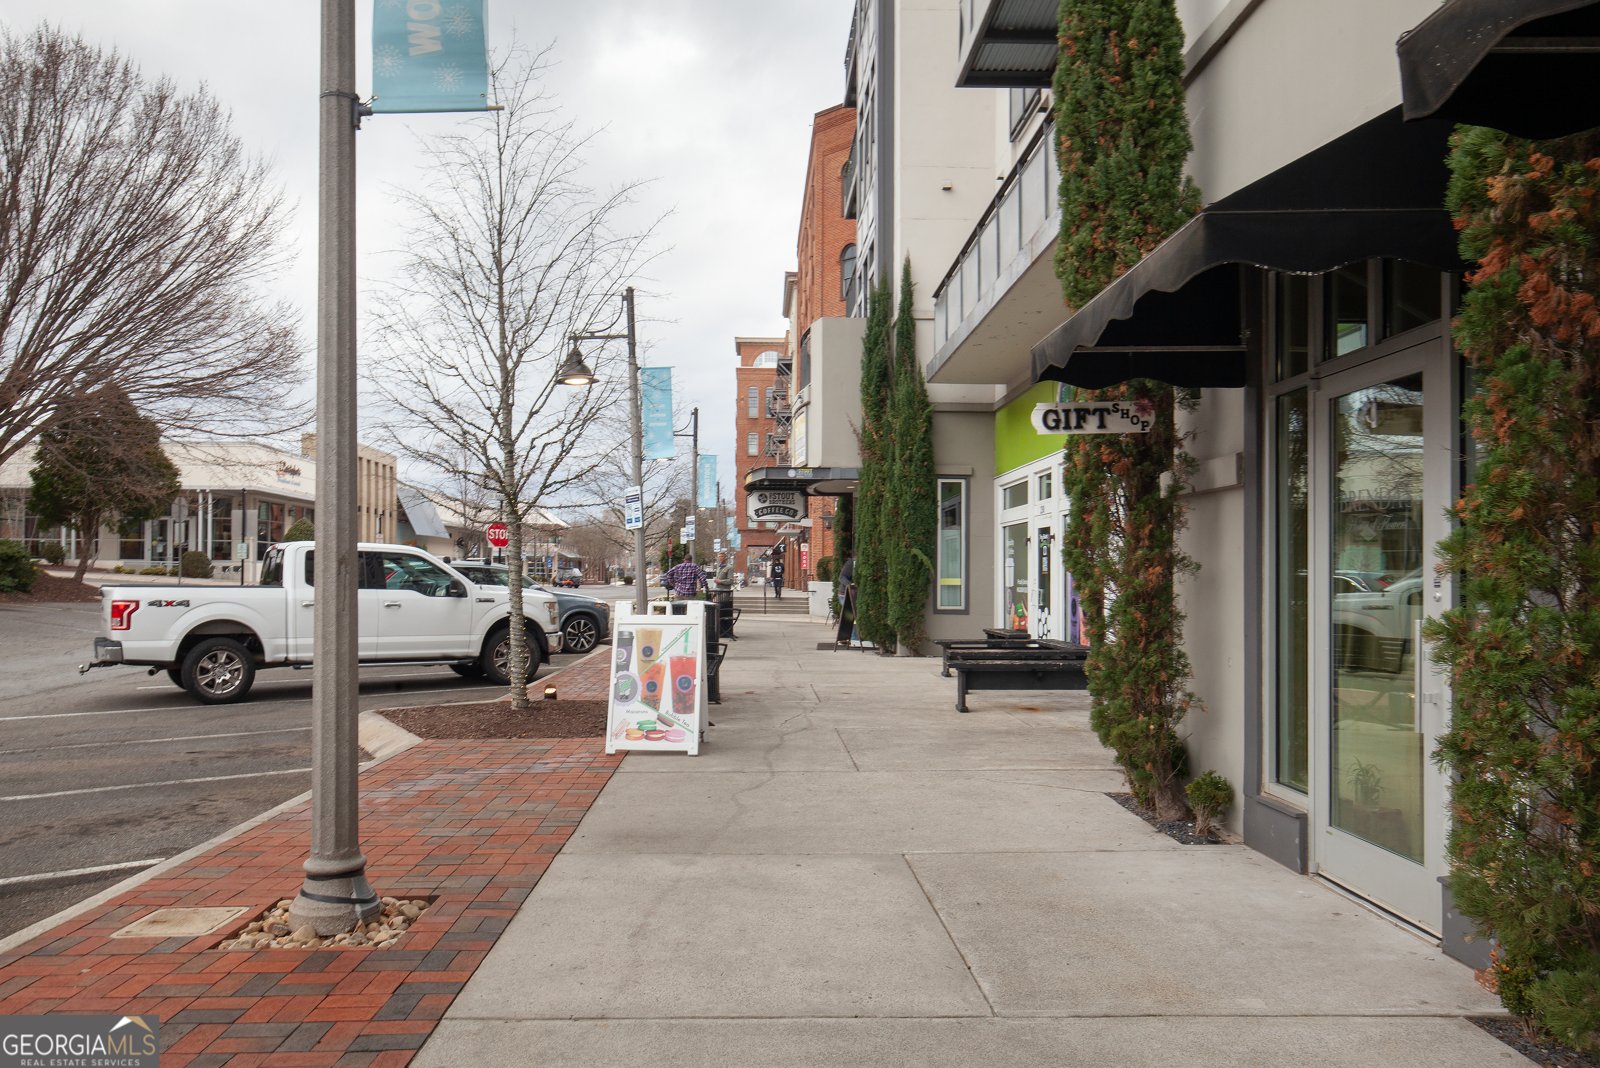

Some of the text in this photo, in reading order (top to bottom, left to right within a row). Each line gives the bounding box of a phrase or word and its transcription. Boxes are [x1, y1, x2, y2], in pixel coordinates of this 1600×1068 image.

[1042, 403, 1150, 431] GIFT SHOP
[758, 507, 783, 515] COFFEE
